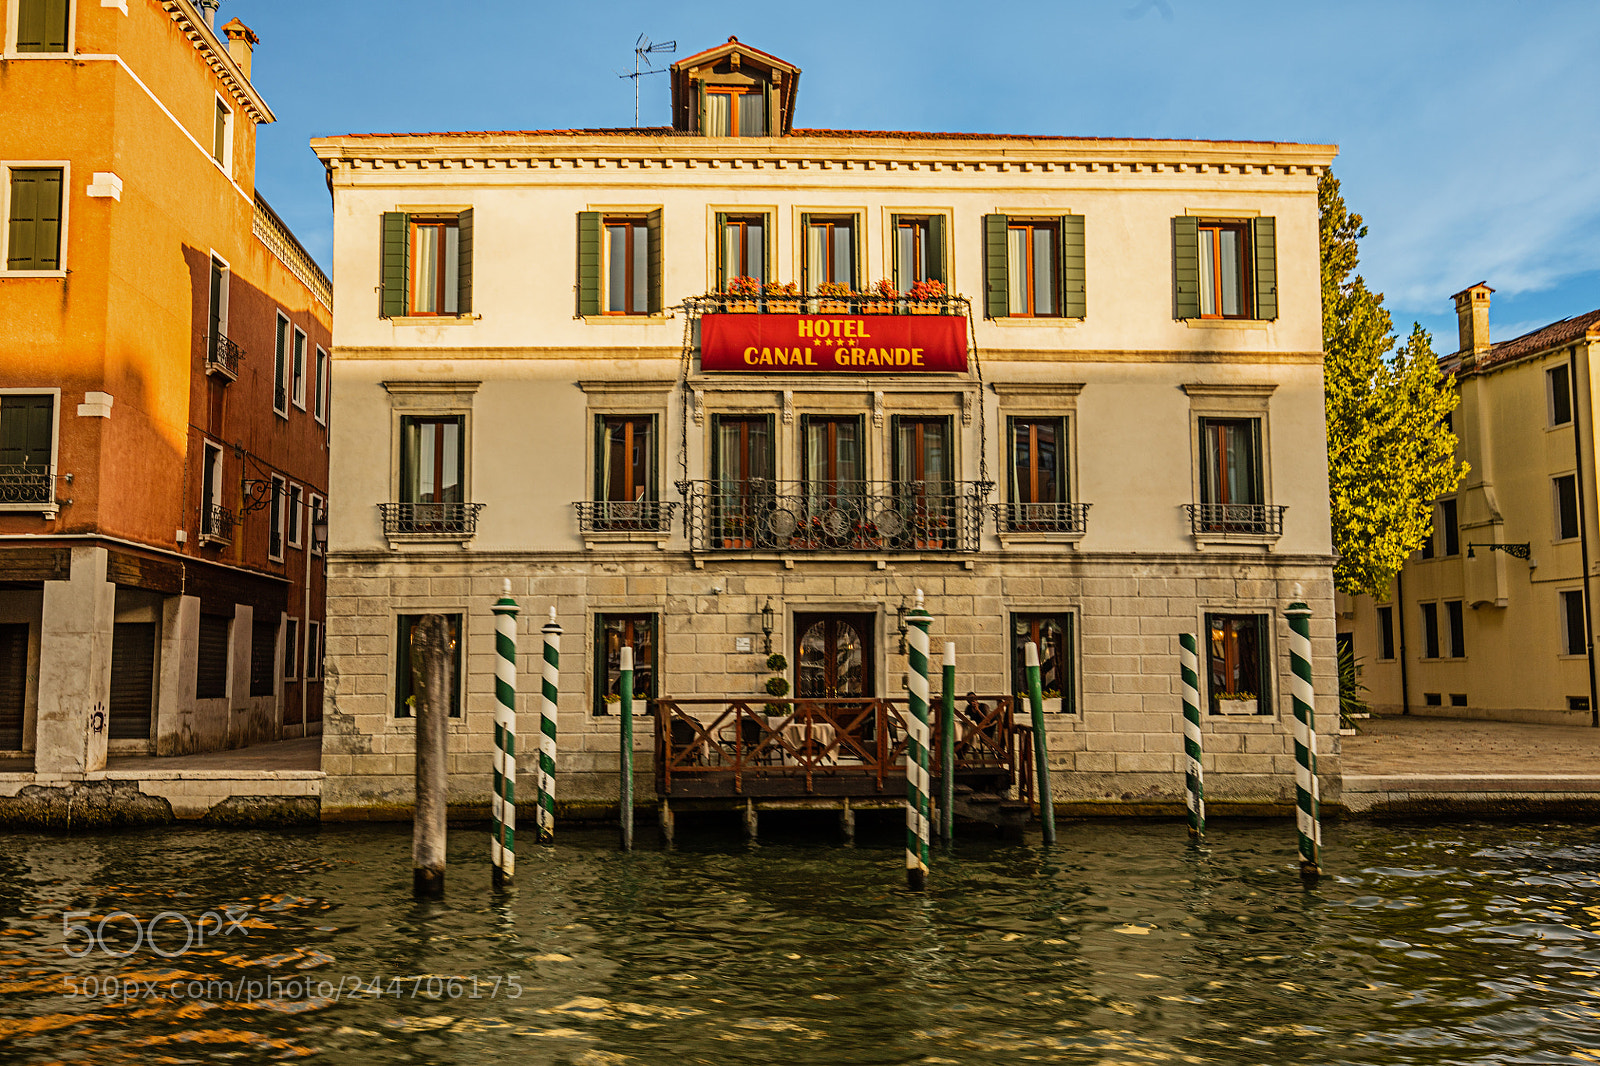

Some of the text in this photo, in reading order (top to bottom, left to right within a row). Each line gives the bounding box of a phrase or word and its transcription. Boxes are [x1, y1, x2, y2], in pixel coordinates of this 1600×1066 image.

[798, 319, 871, 338] HOTEL
[743, 347, 925, 366] CANAL GRANDE
